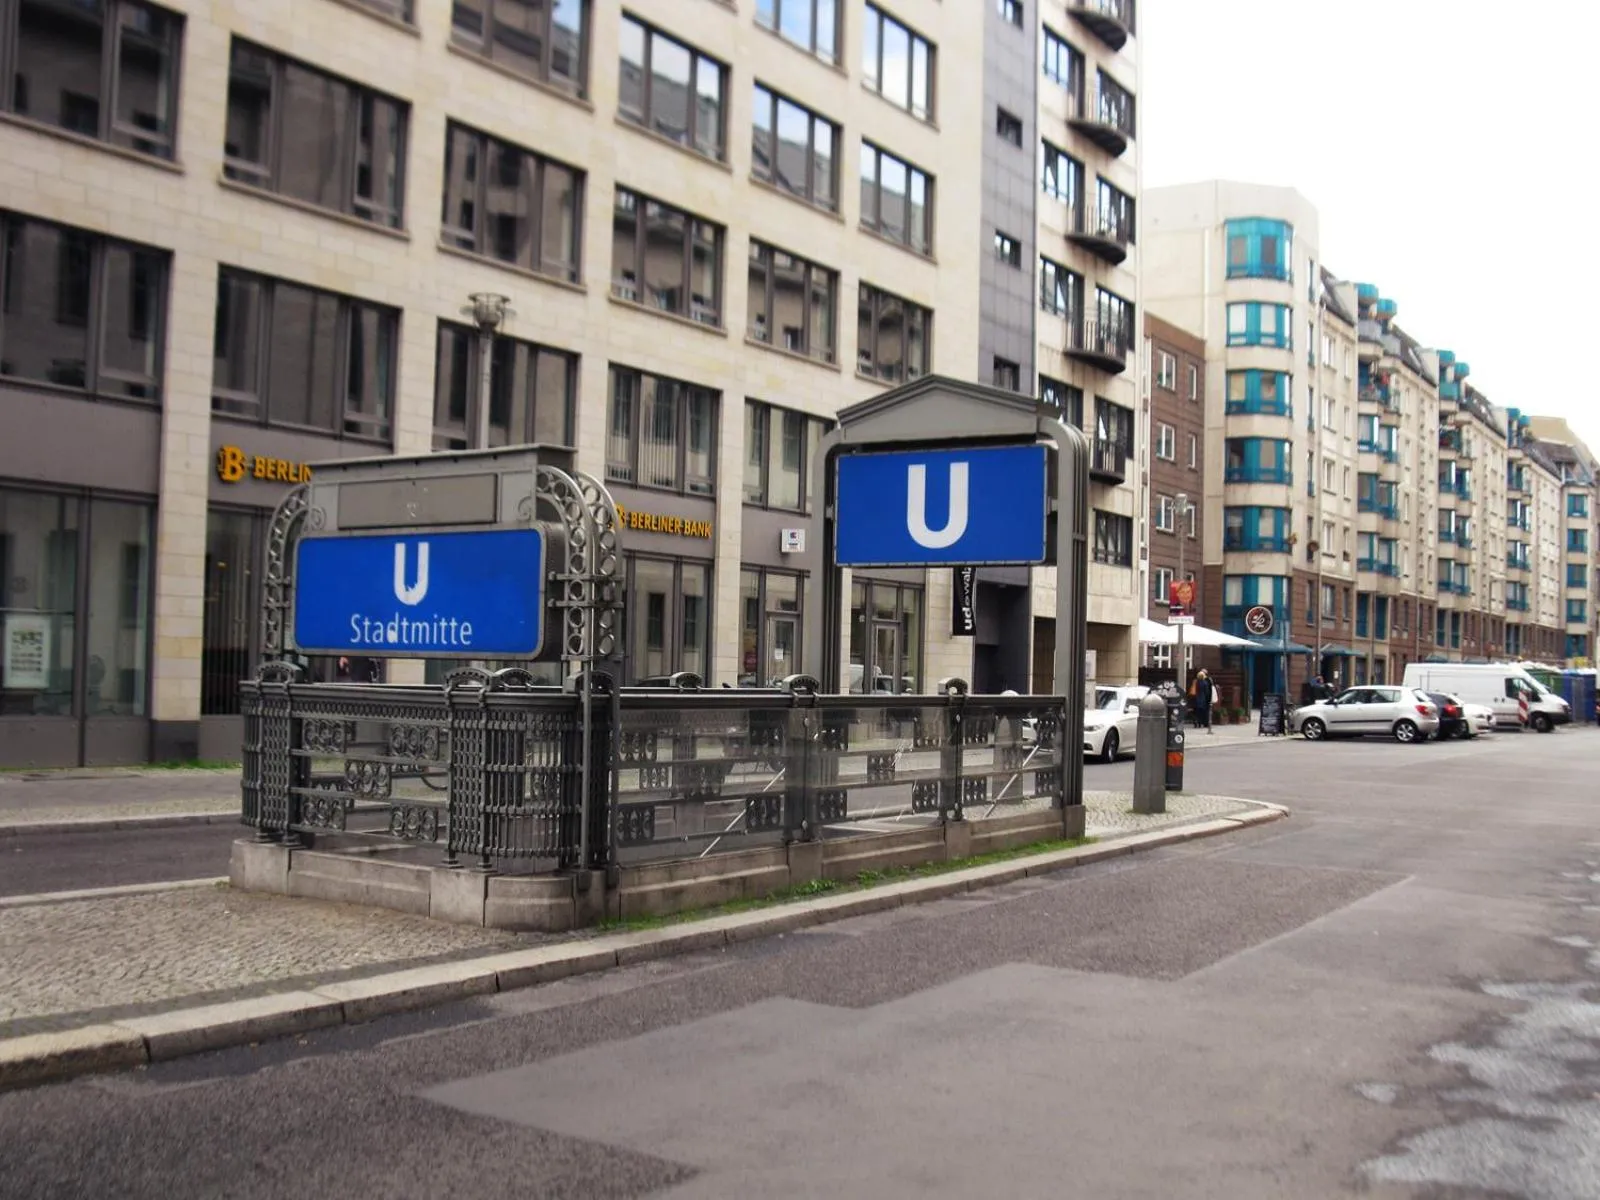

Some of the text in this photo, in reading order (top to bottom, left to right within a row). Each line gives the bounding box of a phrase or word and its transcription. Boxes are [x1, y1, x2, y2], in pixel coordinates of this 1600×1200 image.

[629, 511, 681, 533] BERLINER
[684, 519, 713, 537] BANK
[907, 461, 969, 549] U
[394, 542, 430, 606] U
[350, 611, 473, 645] Stadtmitte
